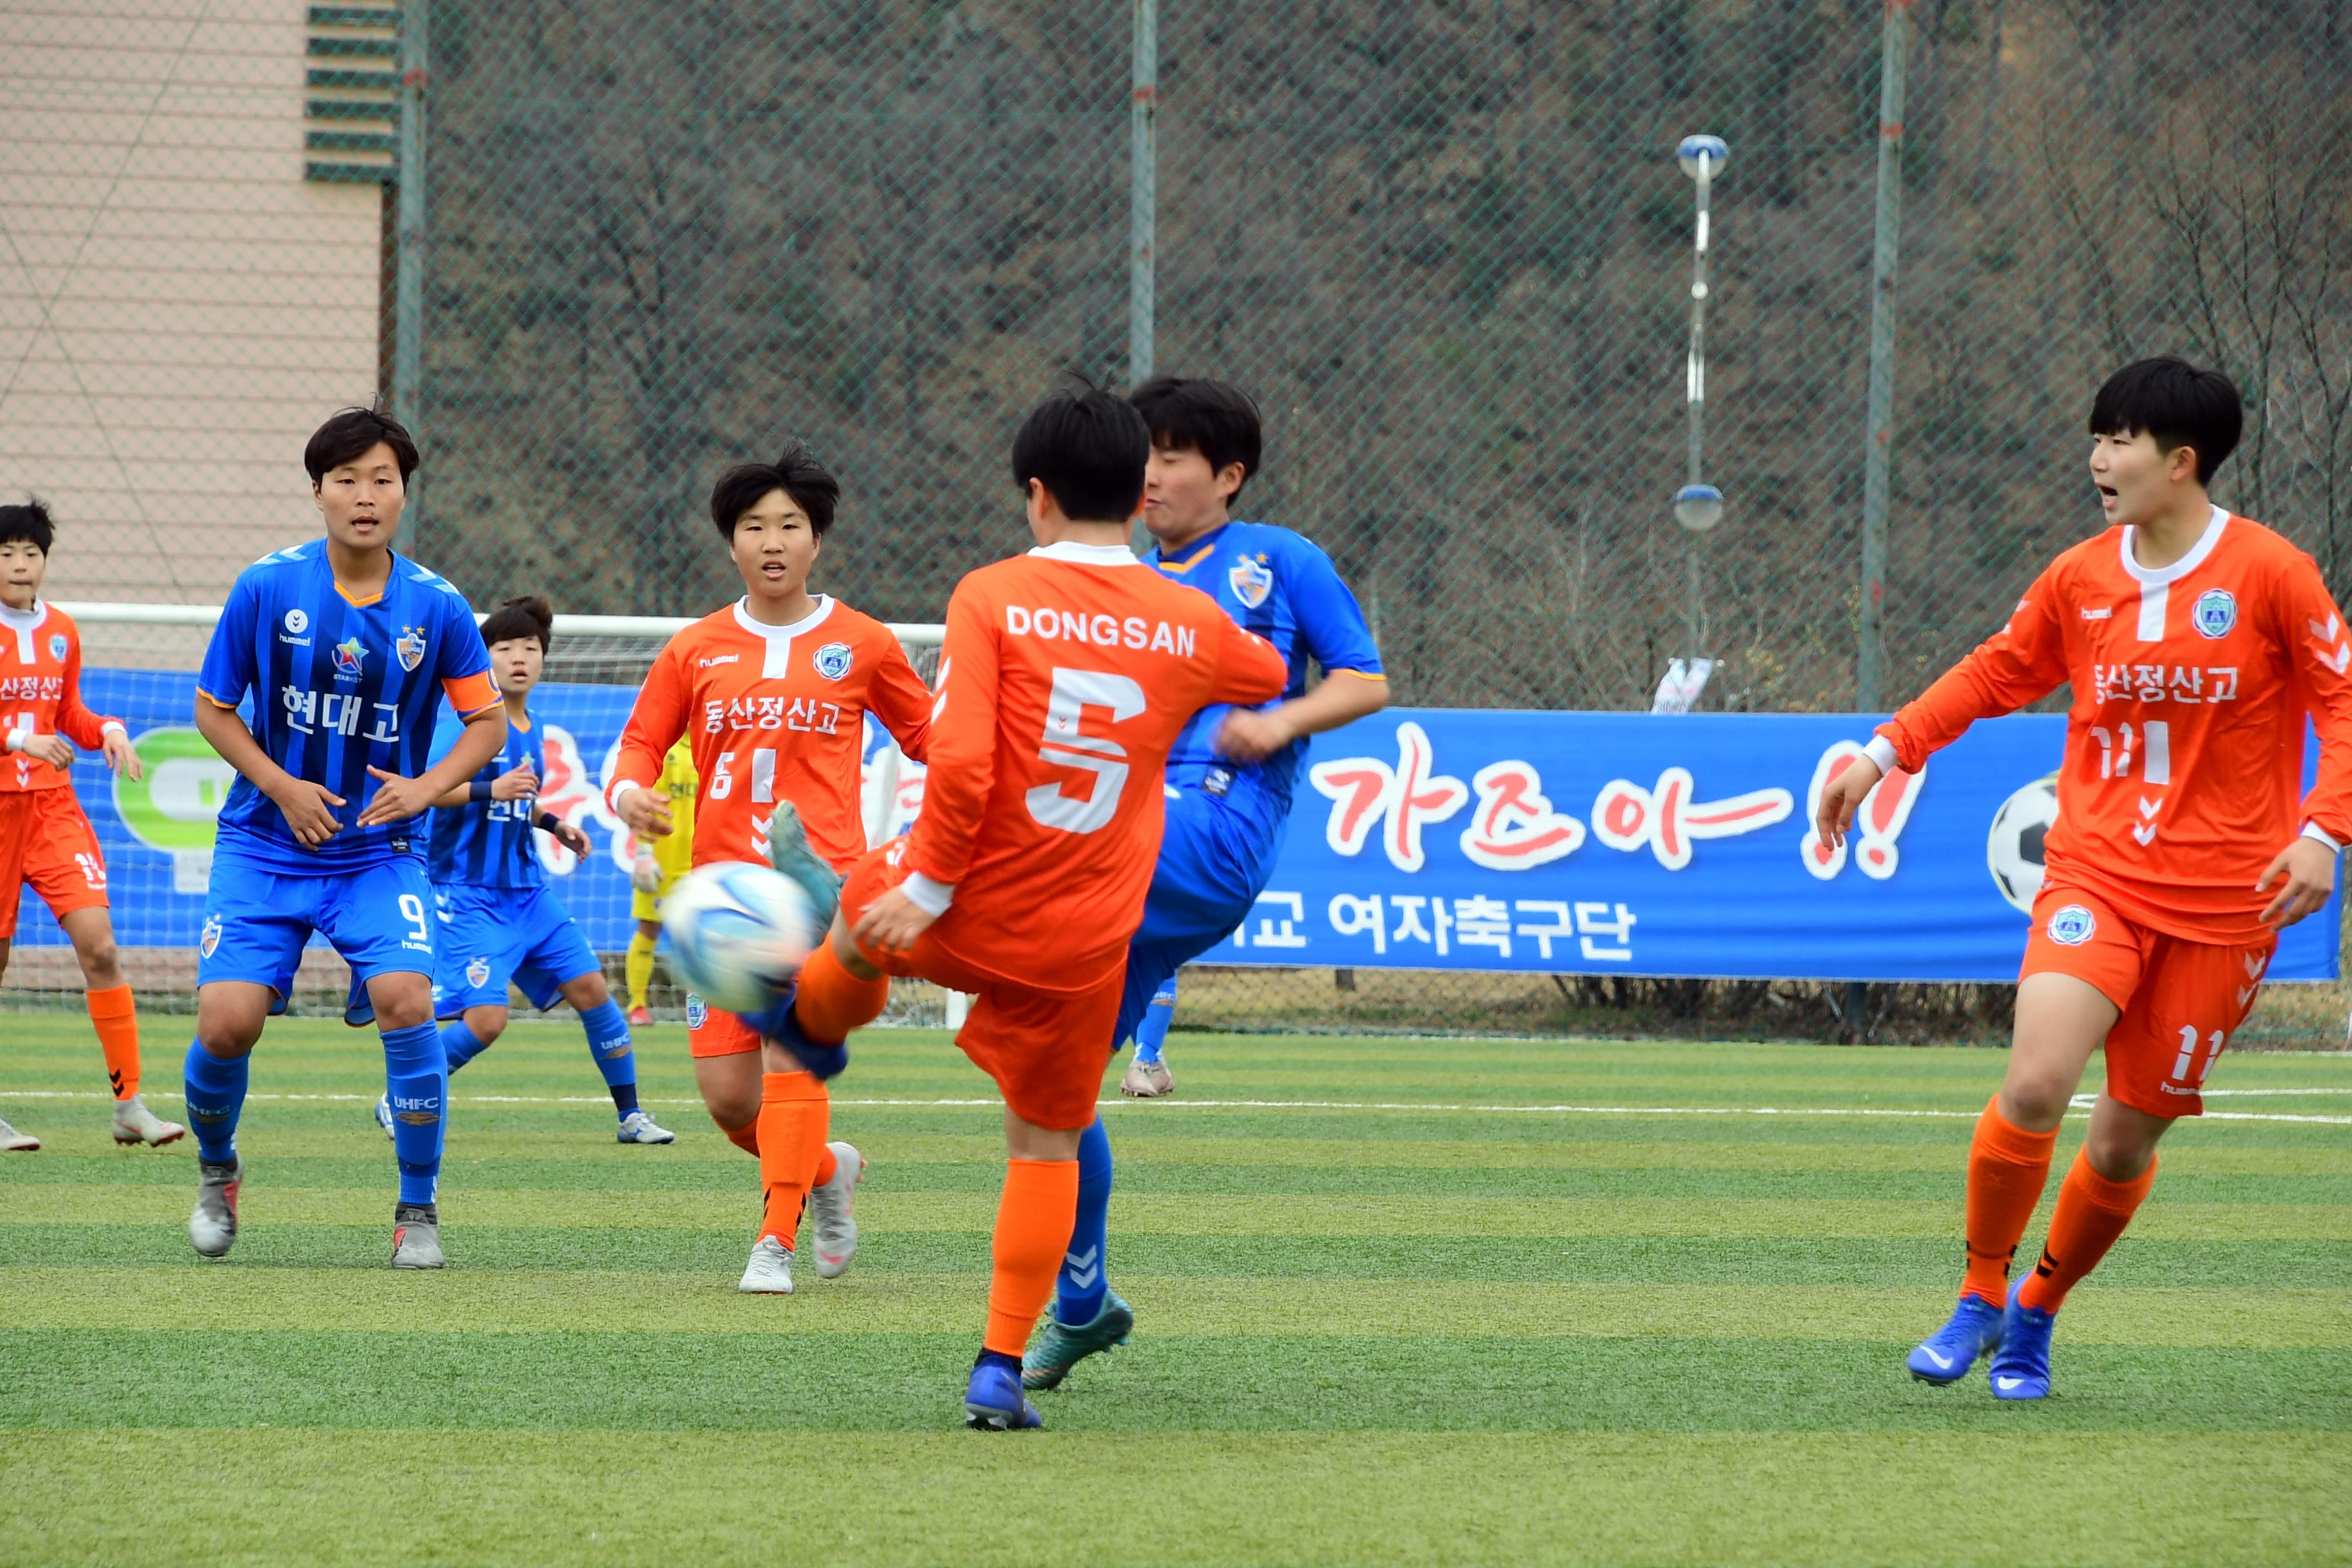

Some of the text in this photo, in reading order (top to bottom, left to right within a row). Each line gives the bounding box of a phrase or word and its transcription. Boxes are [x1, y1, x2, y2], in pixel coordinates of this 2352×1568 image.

[279, 632, 311, 647] hummel
[1006, 605, 1195, 658] DONGSAN
[699, 653, 739, 668] hummel
[281, 685, 400, 743] 현대고
[705, 696, 840, 735] 동산정산고
[710, 752, 735, 799] 6
[1025, 667, 1146, 834] 5
[2090, 721, 2133, 780] 11
[398, 894, 427, 941] 9
[1231, 890, 1638, 961] 교 여자축구단
[2171, 1024, 2224, 1081] 11
[394, 1095, 438, 1110] UHFC
